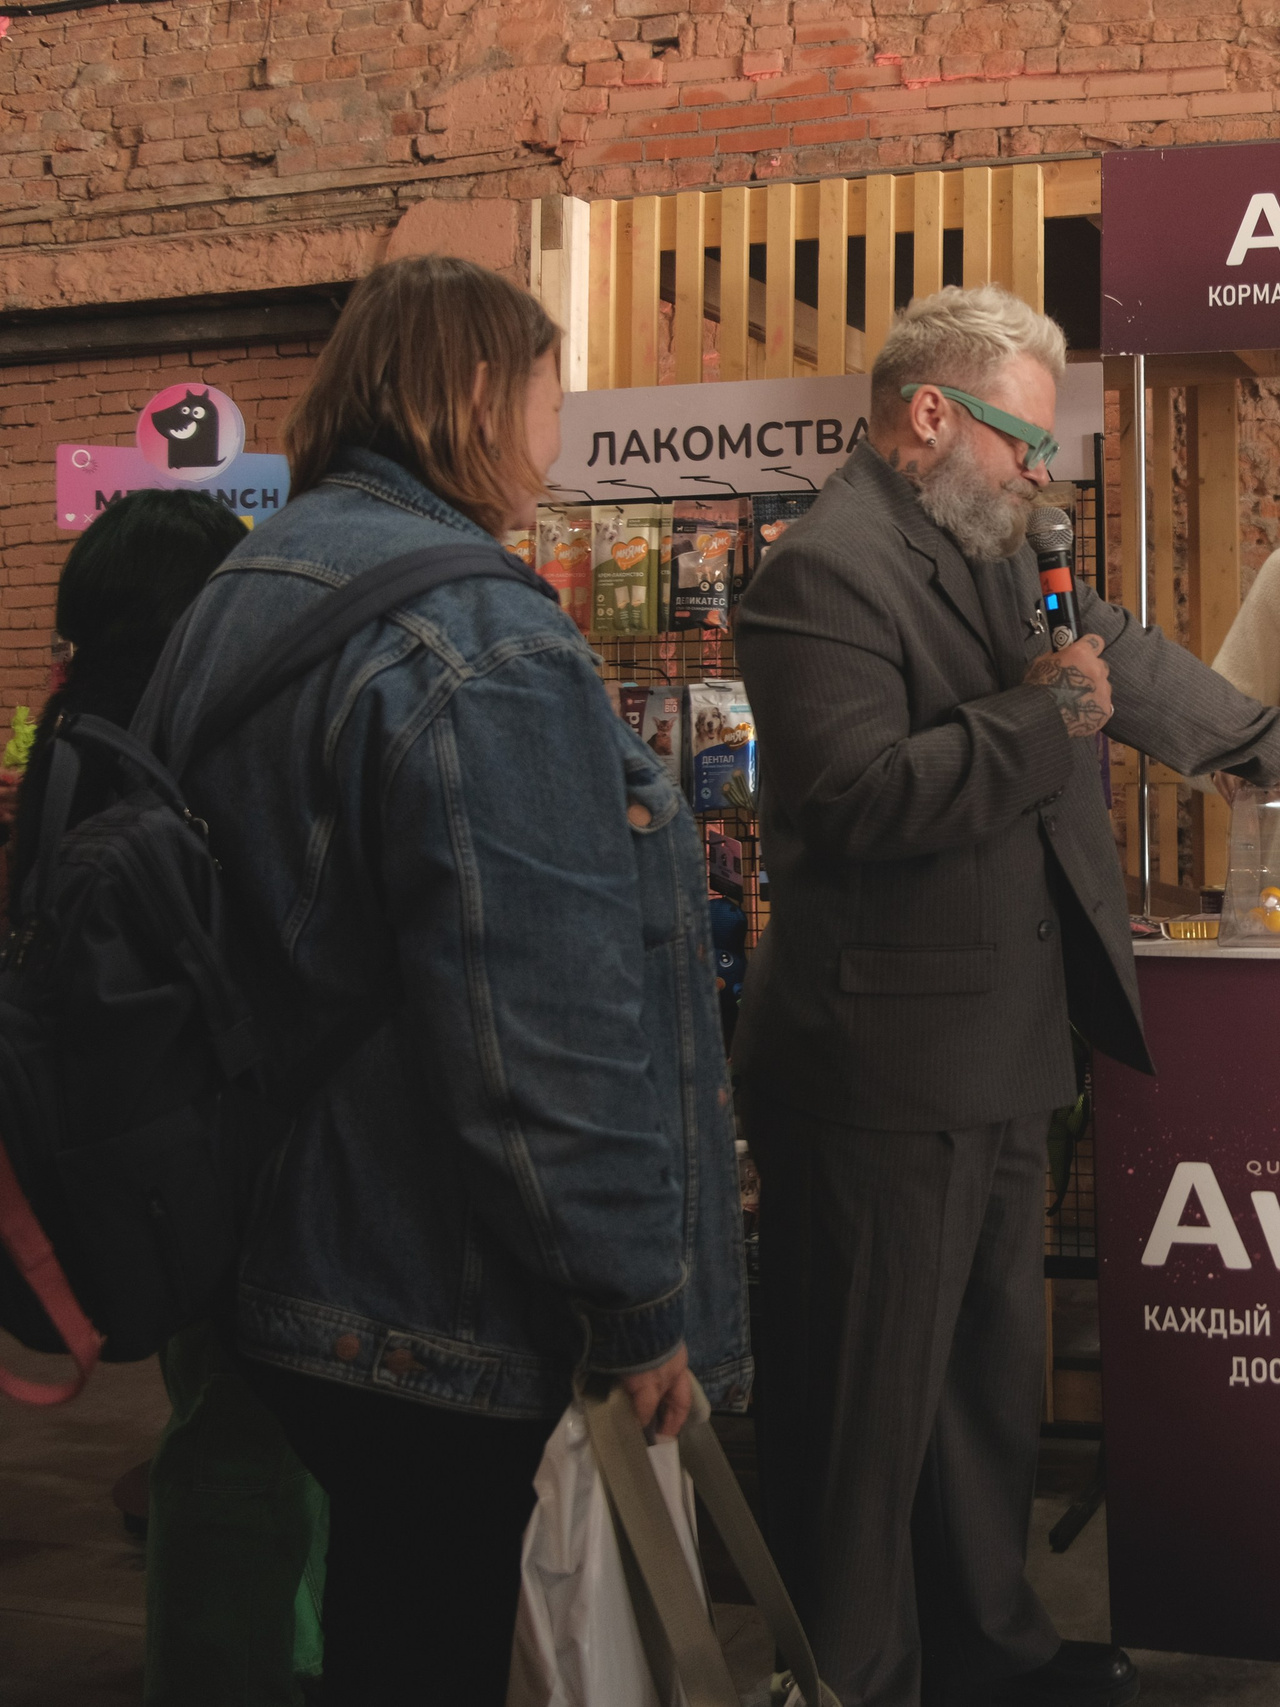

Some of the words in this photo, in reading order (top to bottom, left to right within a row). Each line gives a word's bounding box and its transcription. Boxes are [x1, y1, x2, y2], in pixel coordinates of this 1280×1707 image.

[675, 596, 726, 606] ДЕЛИКАТЕС
[702, 755, 735, 765] ДЕНТАЛ
[1143, 1303, 1271, 1339] КАЖДЫЙ
